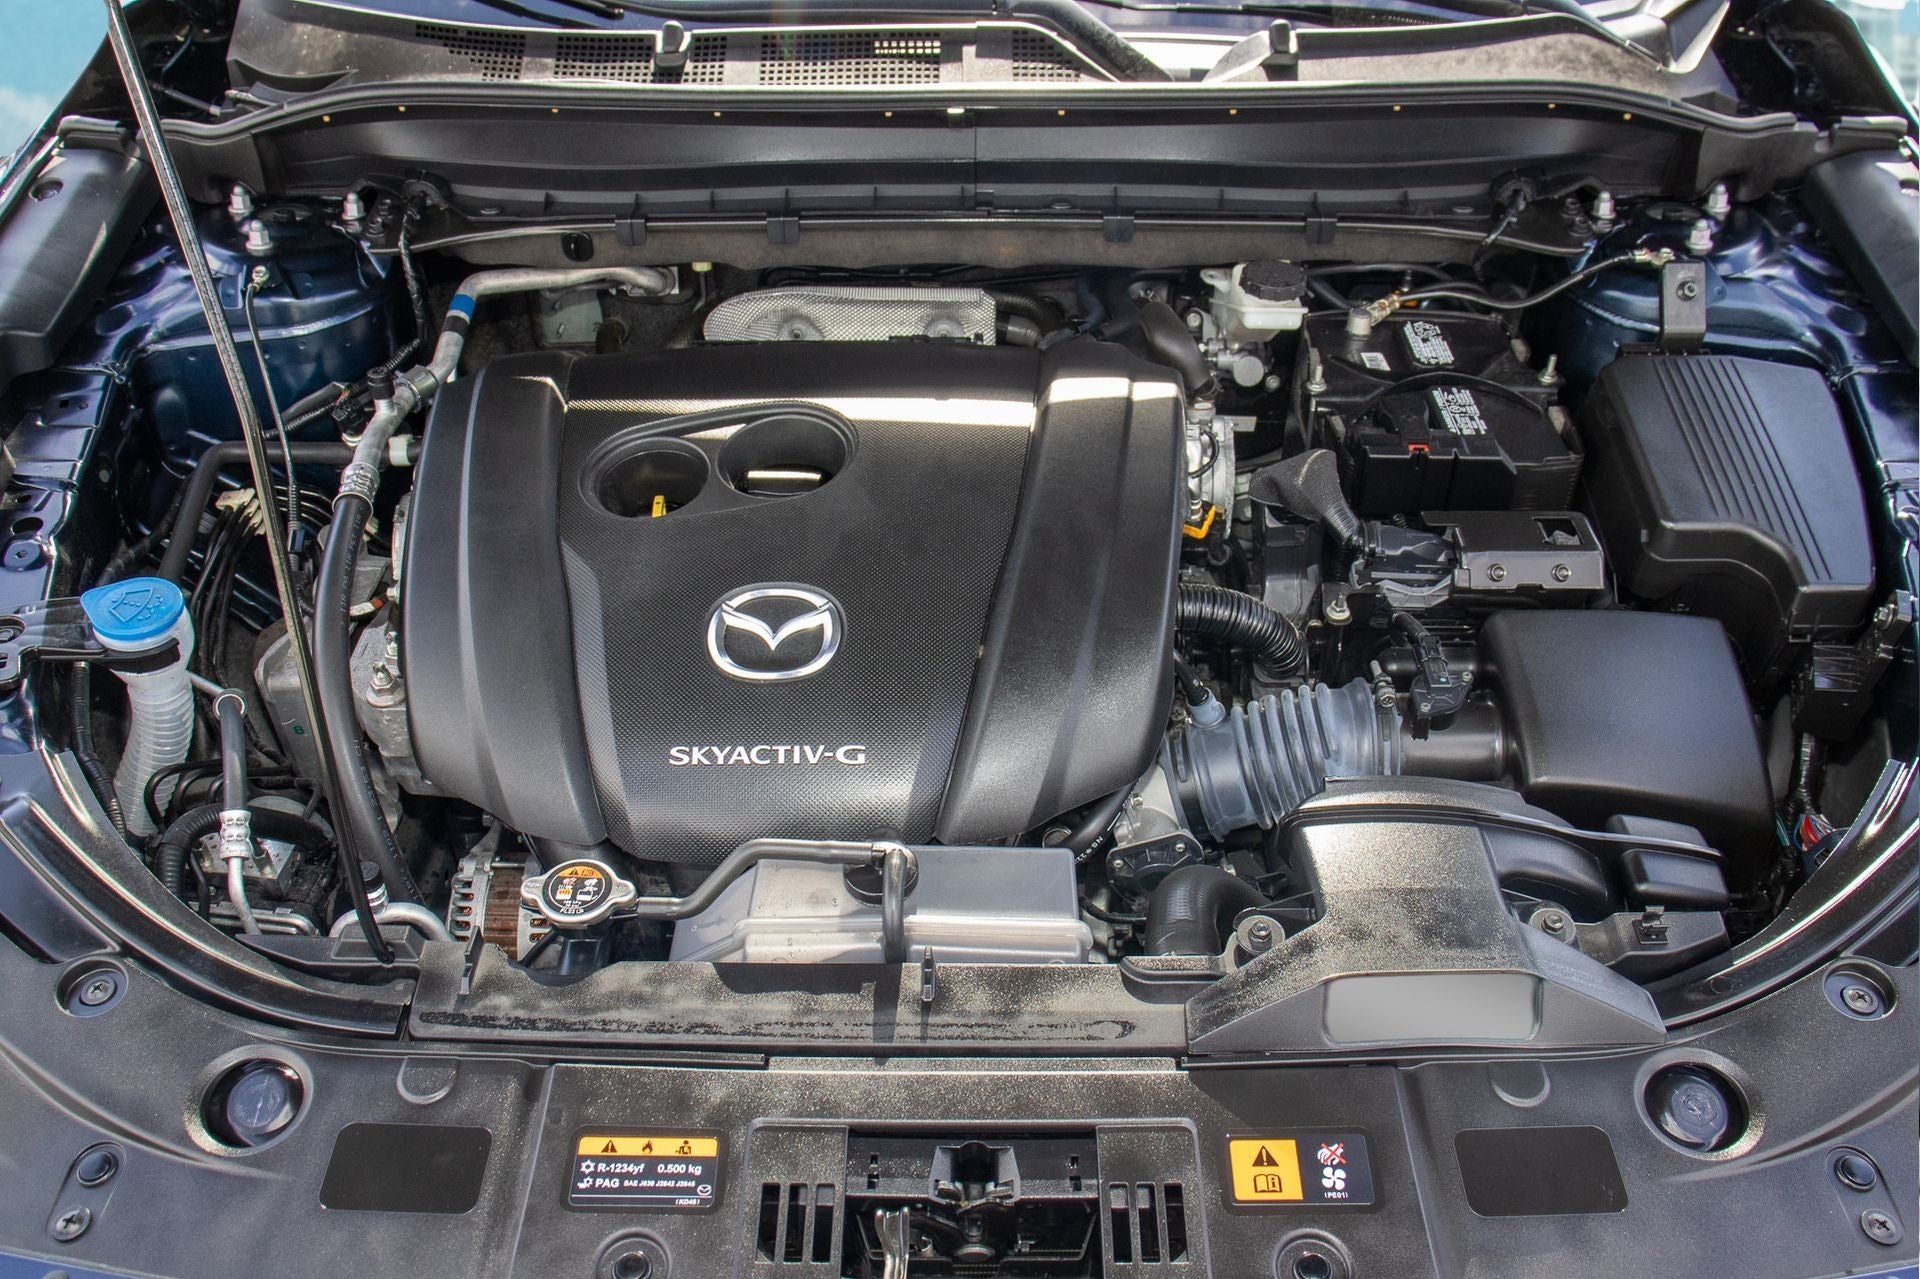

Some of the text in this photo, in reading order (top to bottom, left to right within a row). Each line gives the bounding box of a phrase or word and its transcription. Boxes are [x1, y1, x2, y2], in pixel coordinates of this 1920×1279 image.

[669, 745, 866, 766] SKYACTIV-G
[597, 1162, 702, 1175] R-1234yf 0.500 kg
[595, 1178, 620, 1189] PAG
